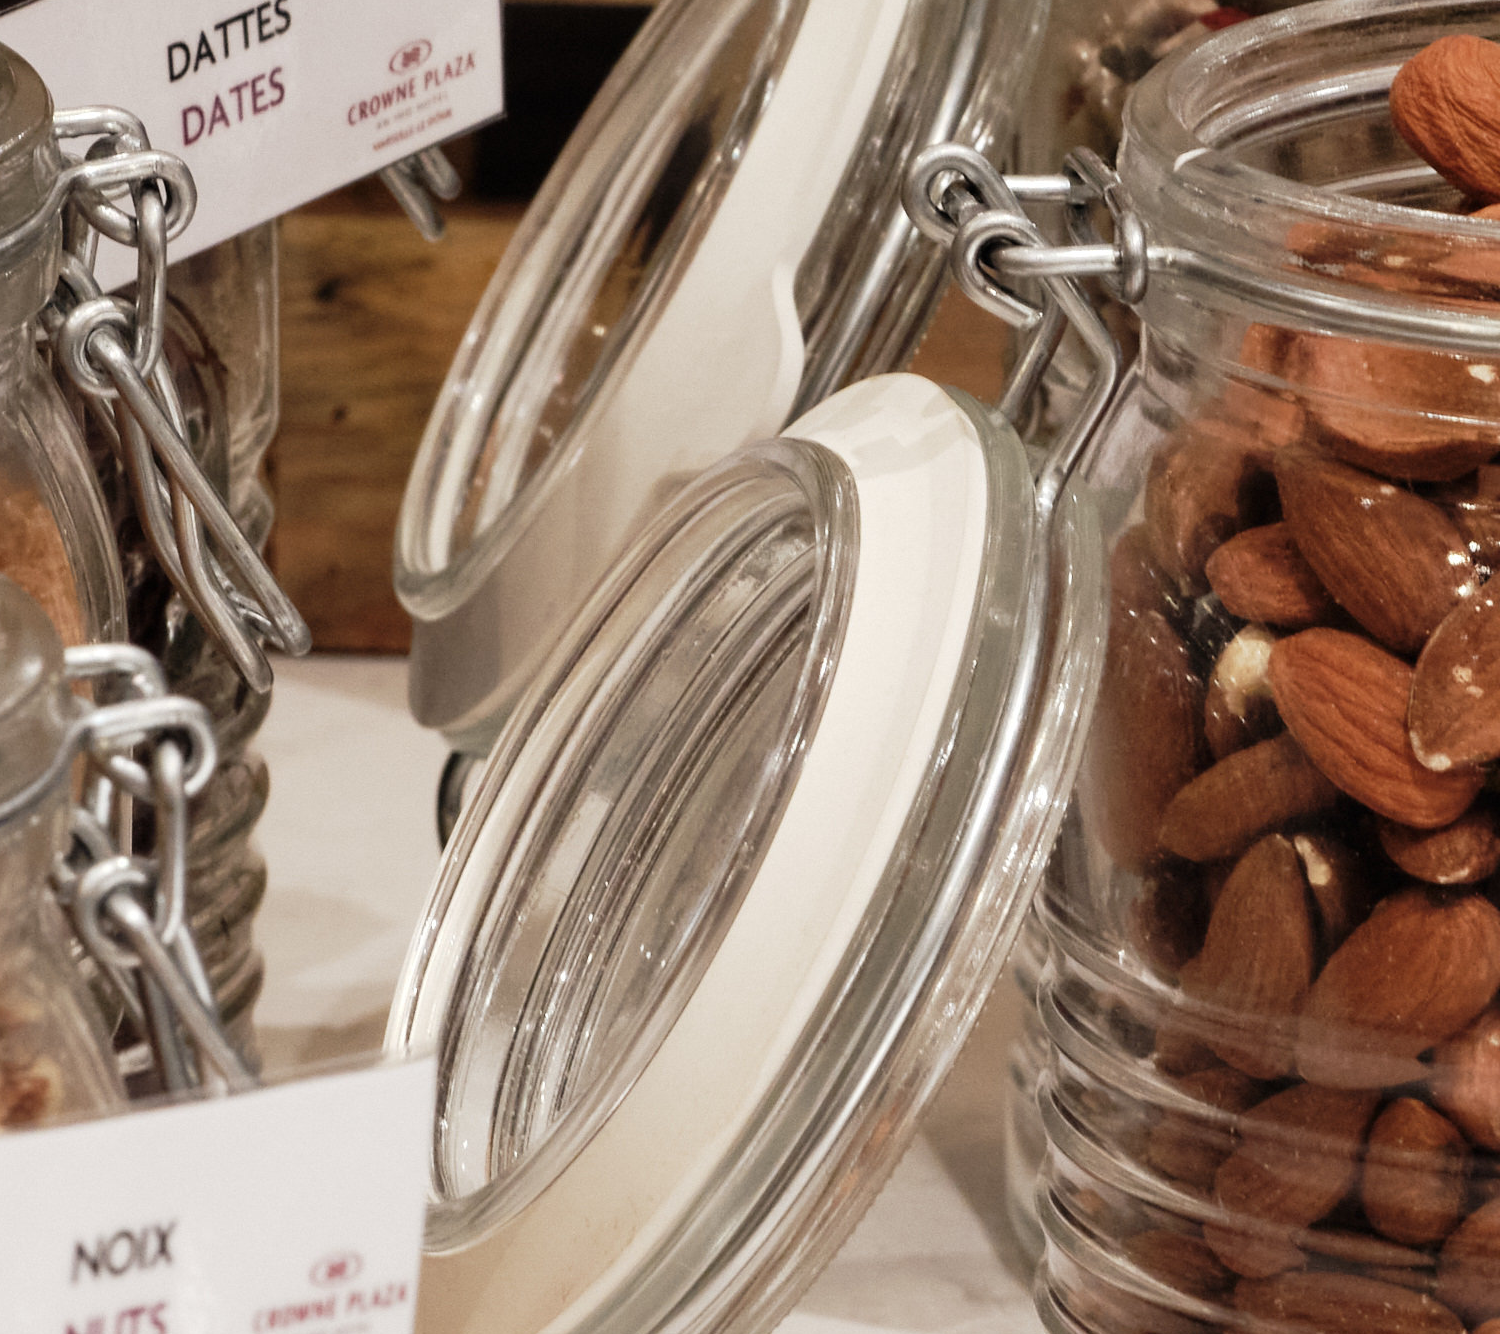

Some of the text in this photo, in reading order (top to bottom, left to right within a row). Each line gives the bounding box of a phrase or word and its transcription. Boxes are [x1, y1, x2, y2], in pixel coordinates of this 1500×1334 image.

[182, 66, 285, 146] DATES
[348, 77, 416, 126] CROWNE
[424, 51, 476, 90] PLAZA
[70, 1218, 177, 1287] NOIX
